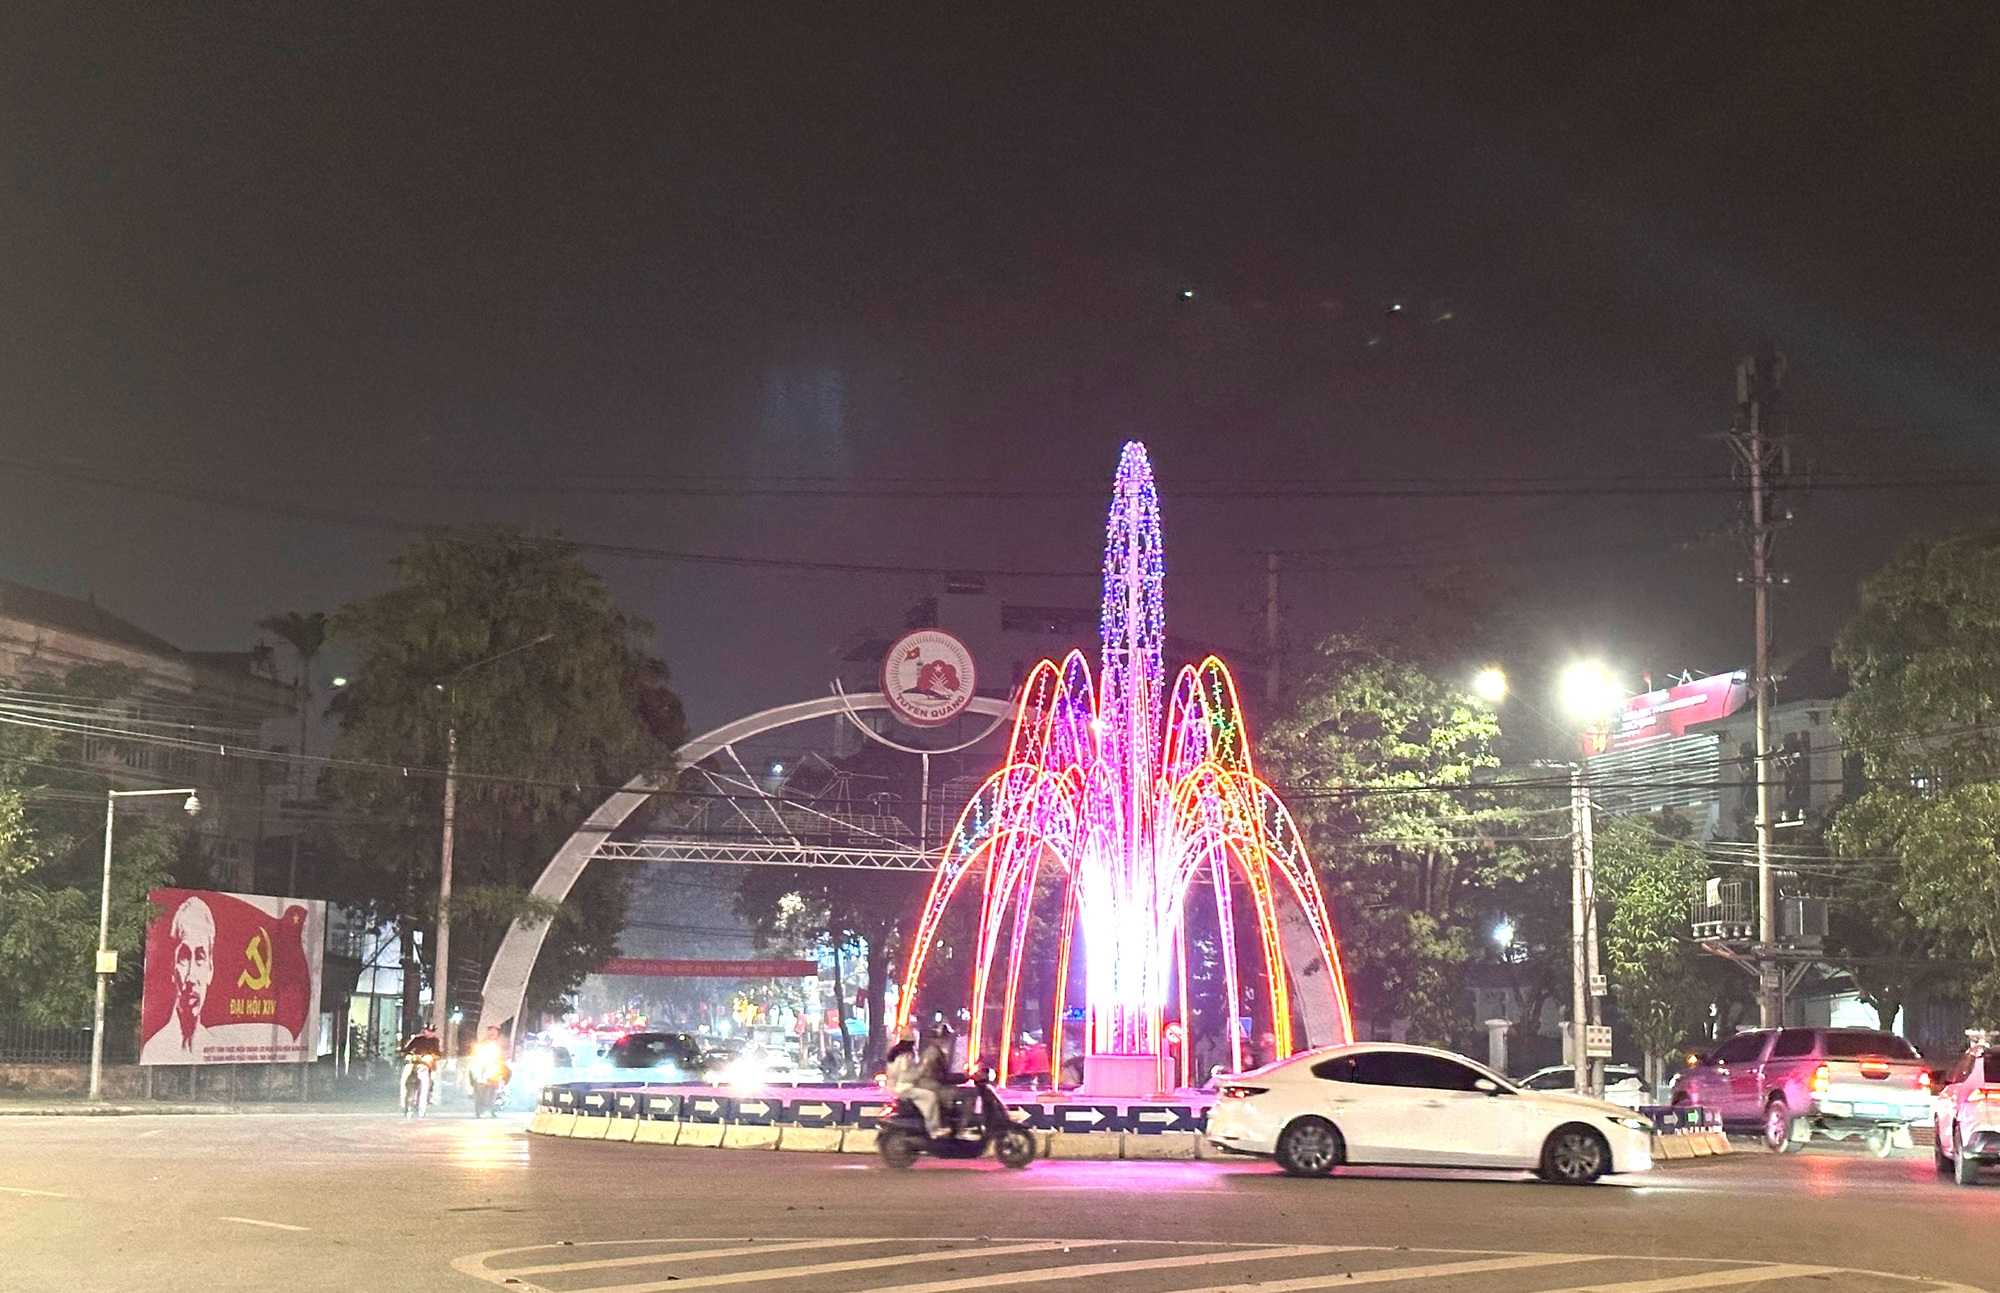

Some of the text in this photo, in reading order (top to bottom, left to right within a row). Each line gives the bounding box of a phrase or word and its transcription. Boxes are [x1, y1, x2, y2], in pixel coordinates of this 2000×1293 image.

[931, 695, 965, 717] QUANG
[230, 996, 277, 1018] ĐẠI HỘI XIV
